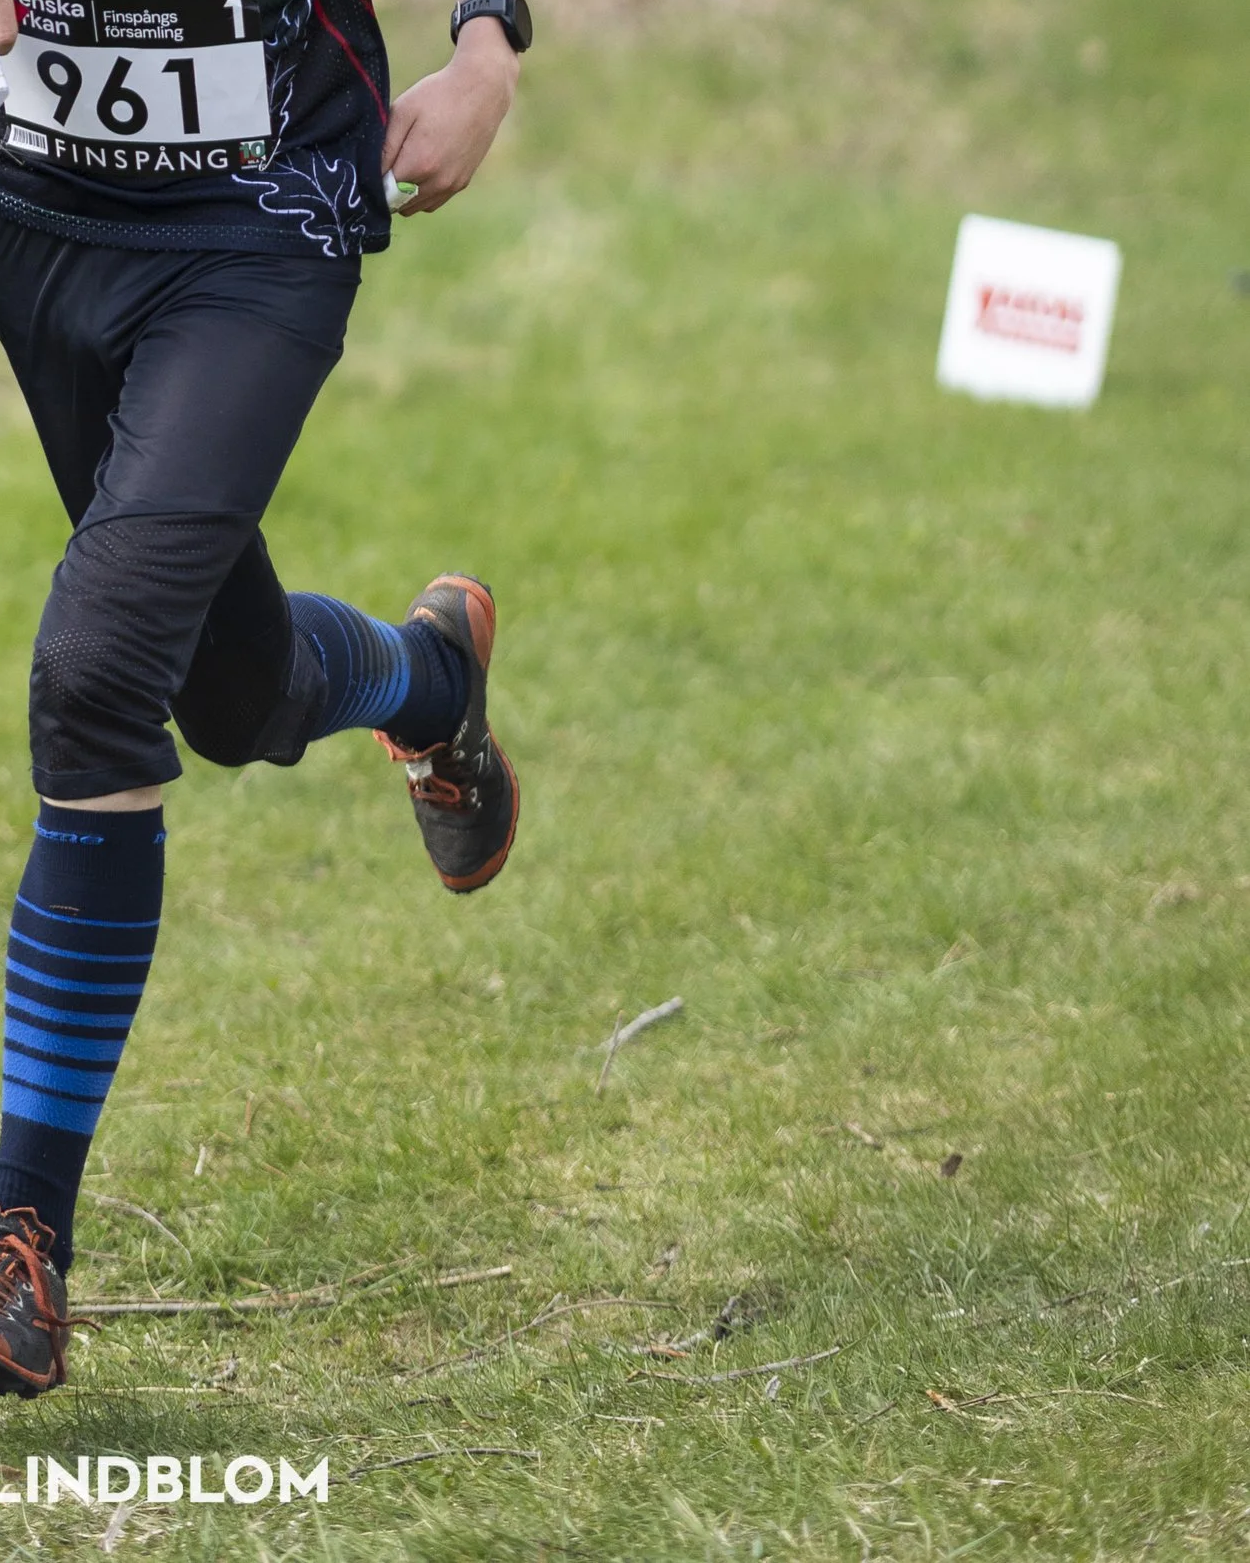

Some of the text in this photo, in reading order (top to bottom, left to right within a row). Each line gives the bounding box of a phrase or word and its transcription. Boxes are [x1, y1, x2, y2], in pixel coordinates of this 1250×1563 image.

[103, 9, 178, 25] Finspångs
[105, 25, 184, 41] församling
[36, 49, 201, 136] 961
[54, 138, 228, 172] FINSPÅNG
[239, 141, 266, 159] 10
